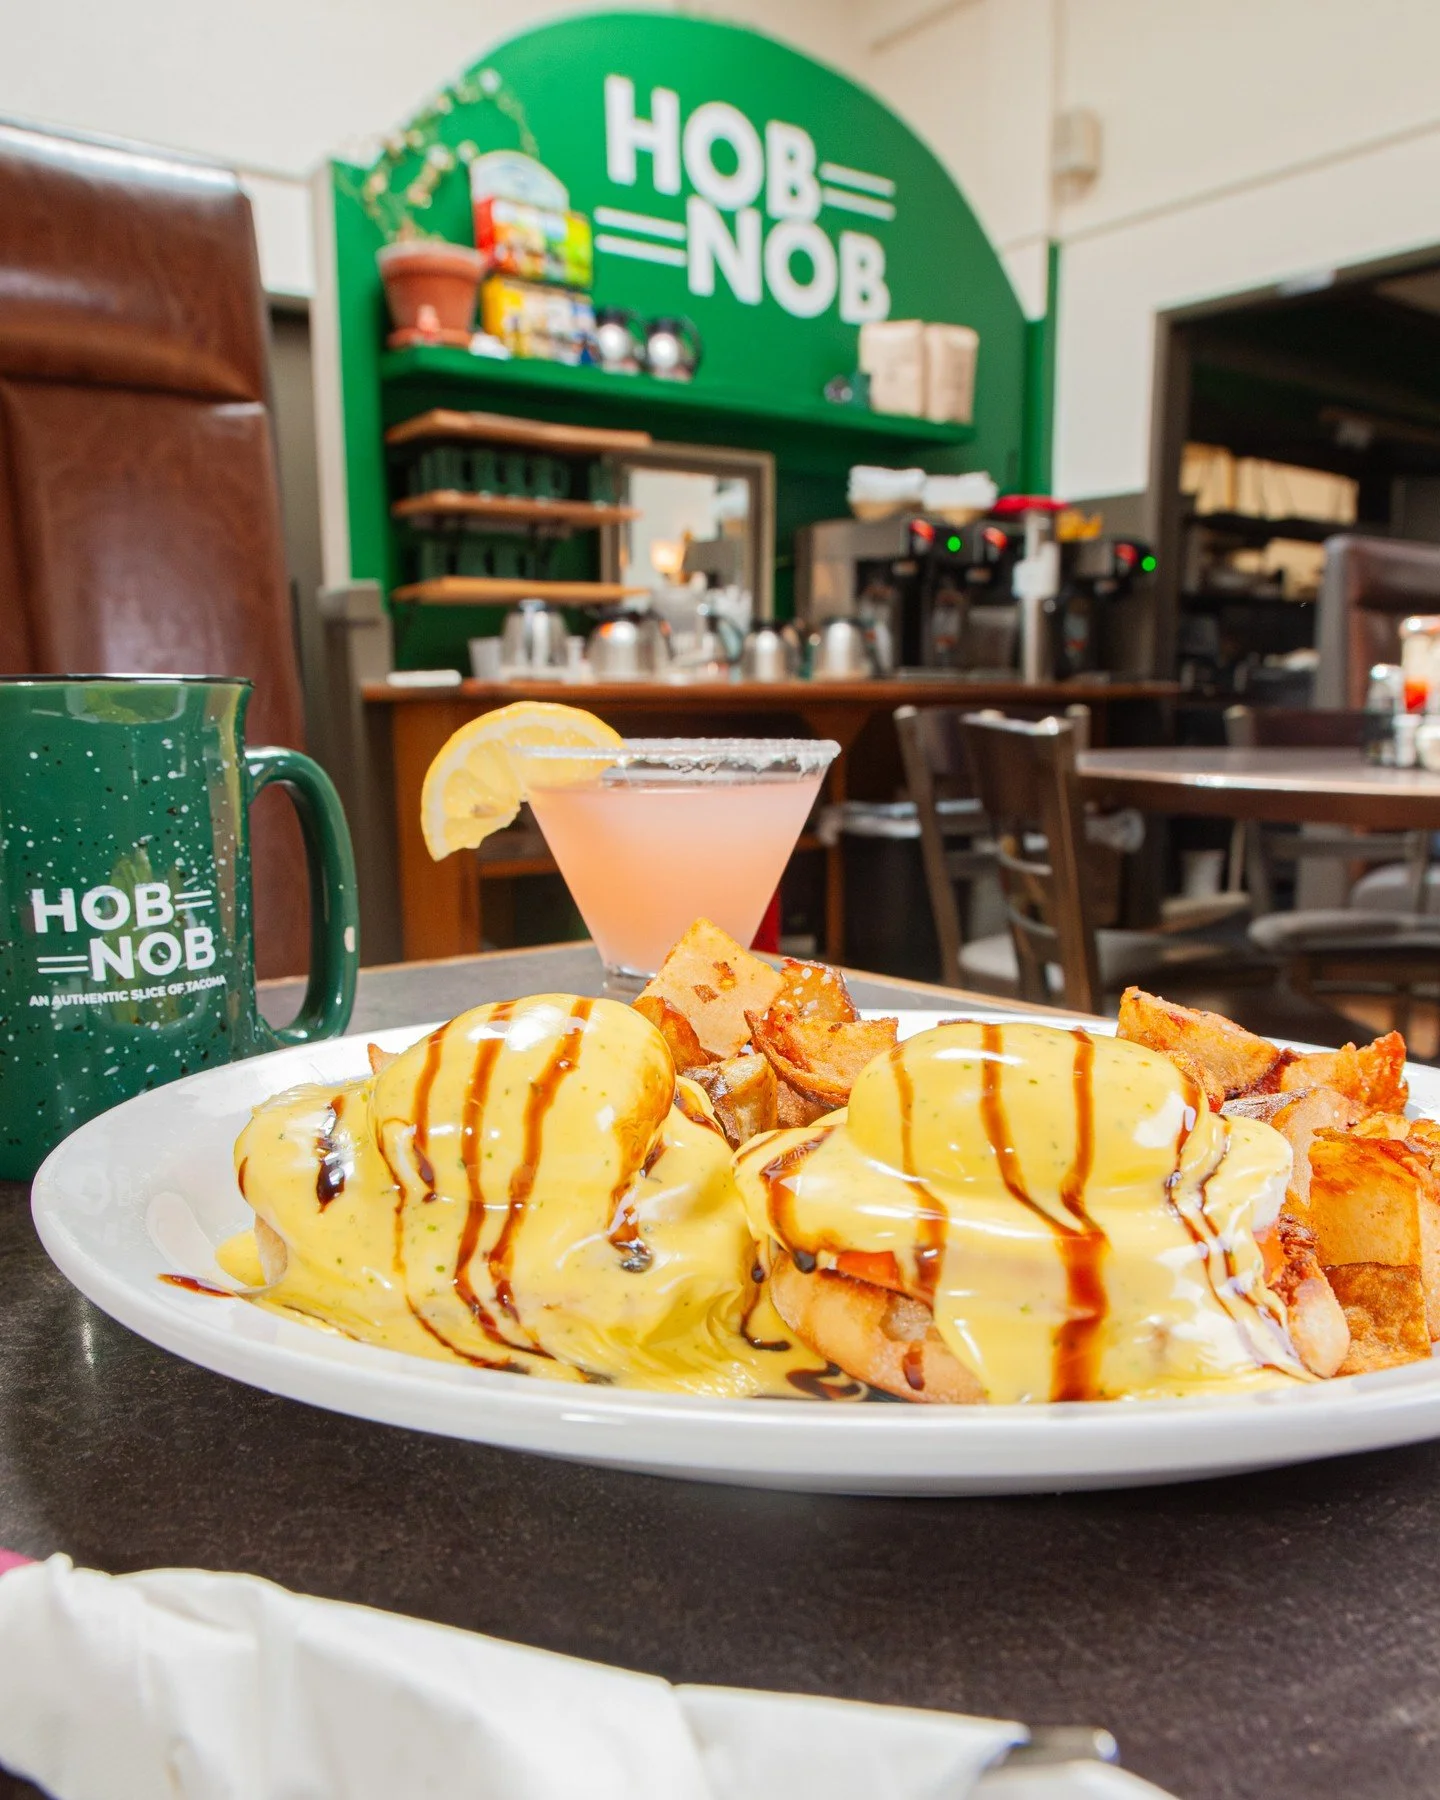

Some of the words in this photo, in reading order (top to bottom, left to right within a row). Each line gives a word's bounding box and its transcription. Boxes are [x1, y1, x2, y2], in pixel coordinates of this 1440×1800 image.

[604, 73, 822, 221] HOB
[686, 194, 891, 324] NOB
[31, 882, 174, 933] HOB
[89, 927, 216, 982] NOB
[29, 995, 49, 1007] AN
[51, 990, 129, 1006] AUTHENTIC
[130, 985, 166, 1000] SLICE
[168, 983, 186, 995] OF
[187, 974, 227, 993] TACOMA
